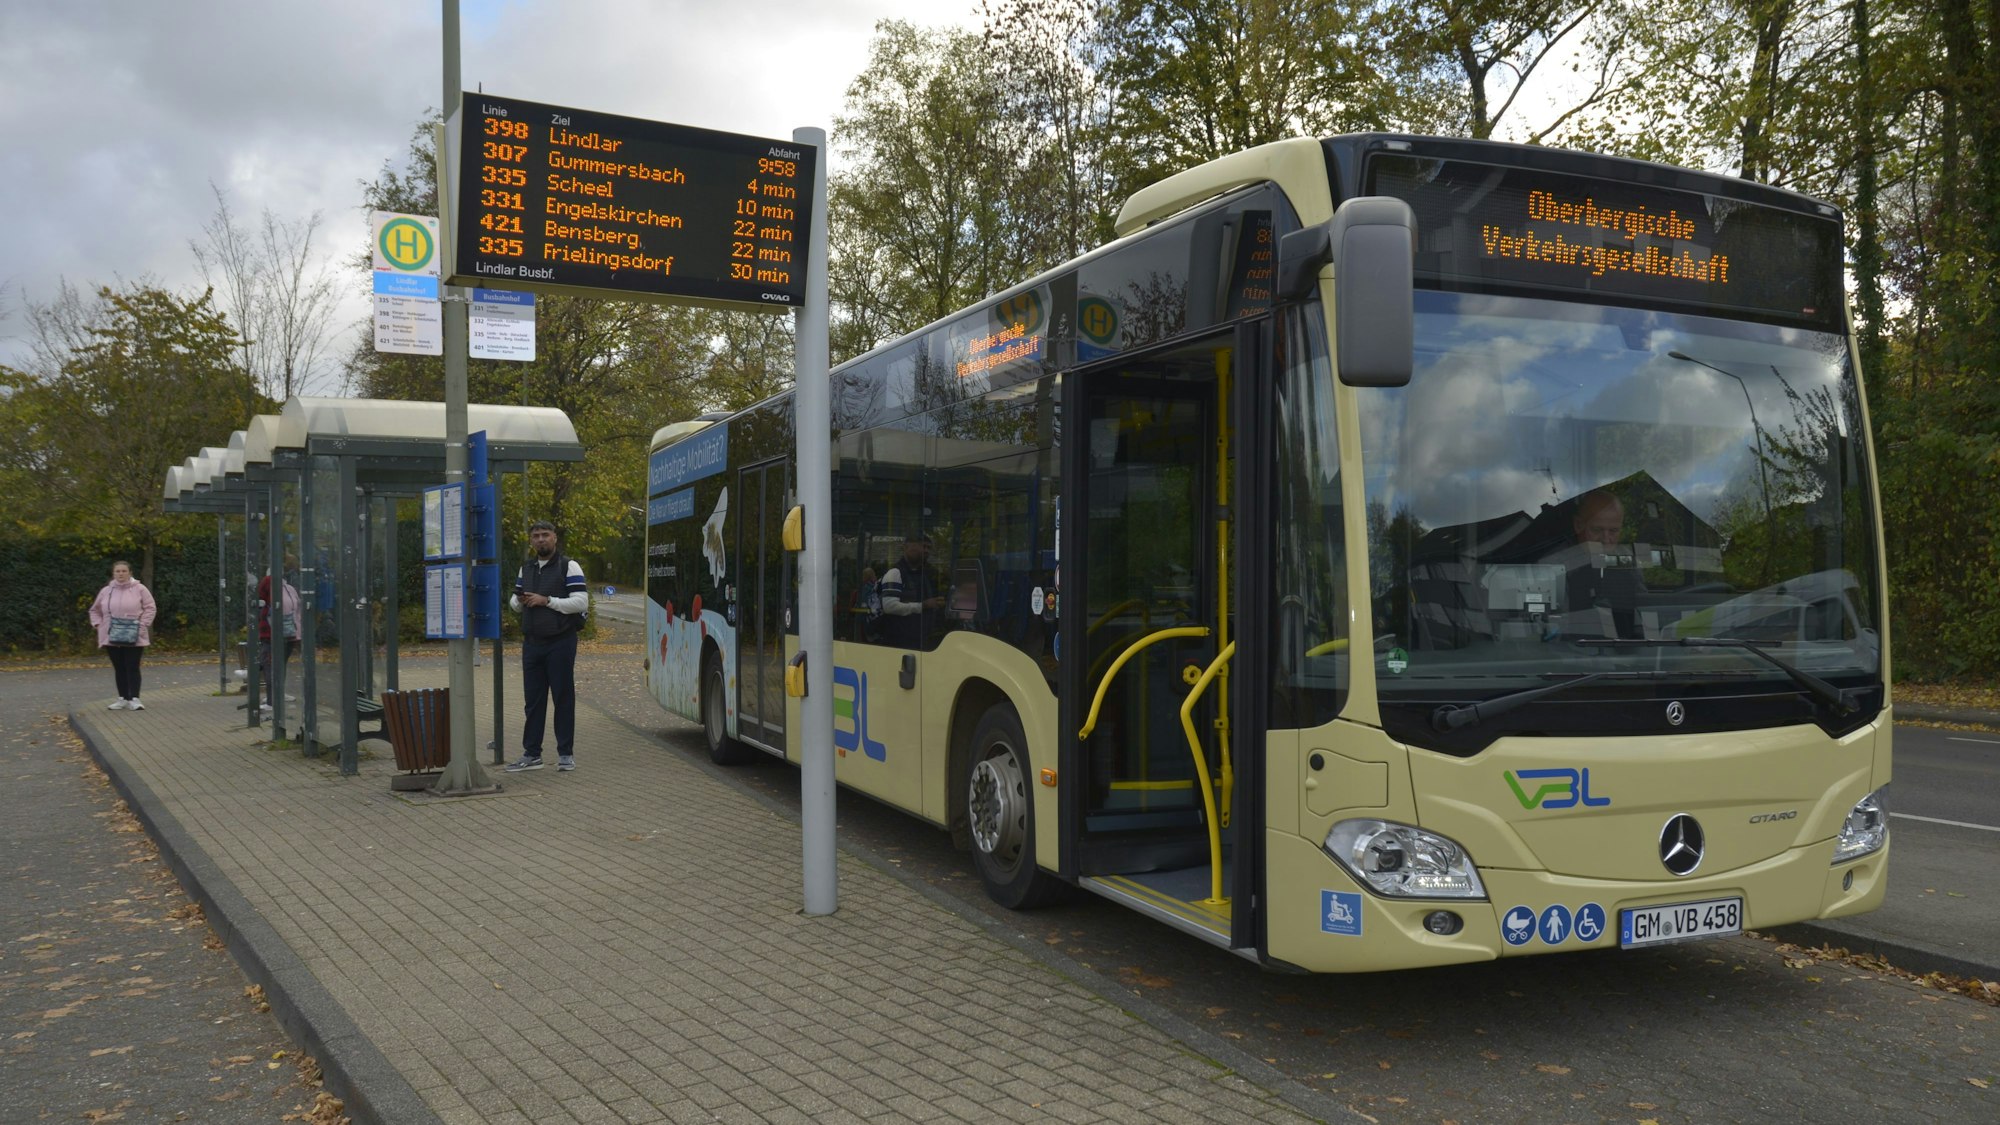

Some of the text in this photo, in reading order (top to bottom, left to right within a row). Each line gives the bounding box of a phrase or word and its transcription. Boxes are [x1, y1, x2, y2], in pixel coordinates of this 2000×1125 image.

[482, 104, 571, 126] Linie Ziel
[484, 117, 796, 177] 398 Lindlar 9:58
[768, 147, 800, 160] Abfahrt
[483, 142, 796, 199] 307 Gummersbach 4 min
[482, 165, 794, 220] 335 Scheel 10 min
[481, 189, 793, 242] 331 Engelskirchen 22 min
[1528, 190, 1695, 240] Oberbergische
[396, 229, 418, 259] H
[480, 213, 791, 263] 421 Bensberg 22 min
[1483, 225, 1729, 284] Verkehrsgesellschaft
[476, 261, 555, 280] Lindlar Busbf.
[479, 236, 789, 284] 335 Frielingsdorf 30 min
[484, 293, 520, 302] Busbahnhof
[762, 292, 790, 302] OVAG
[957, 335, 1039, 378] Verkehrsgesellschaft
[969, 322, 1025, 355] Oberbergische
[651, 434, 724, 487] Nachhaltige Mobilität?
[833, 666, 886, 763] BL
[1503, 767, 1611, 810] VBL
[1749, 811, 1797, 824] CITARO
[1624, 930, 1630, 939] D
[1635, 904, 1737, 938] GM VB 458
